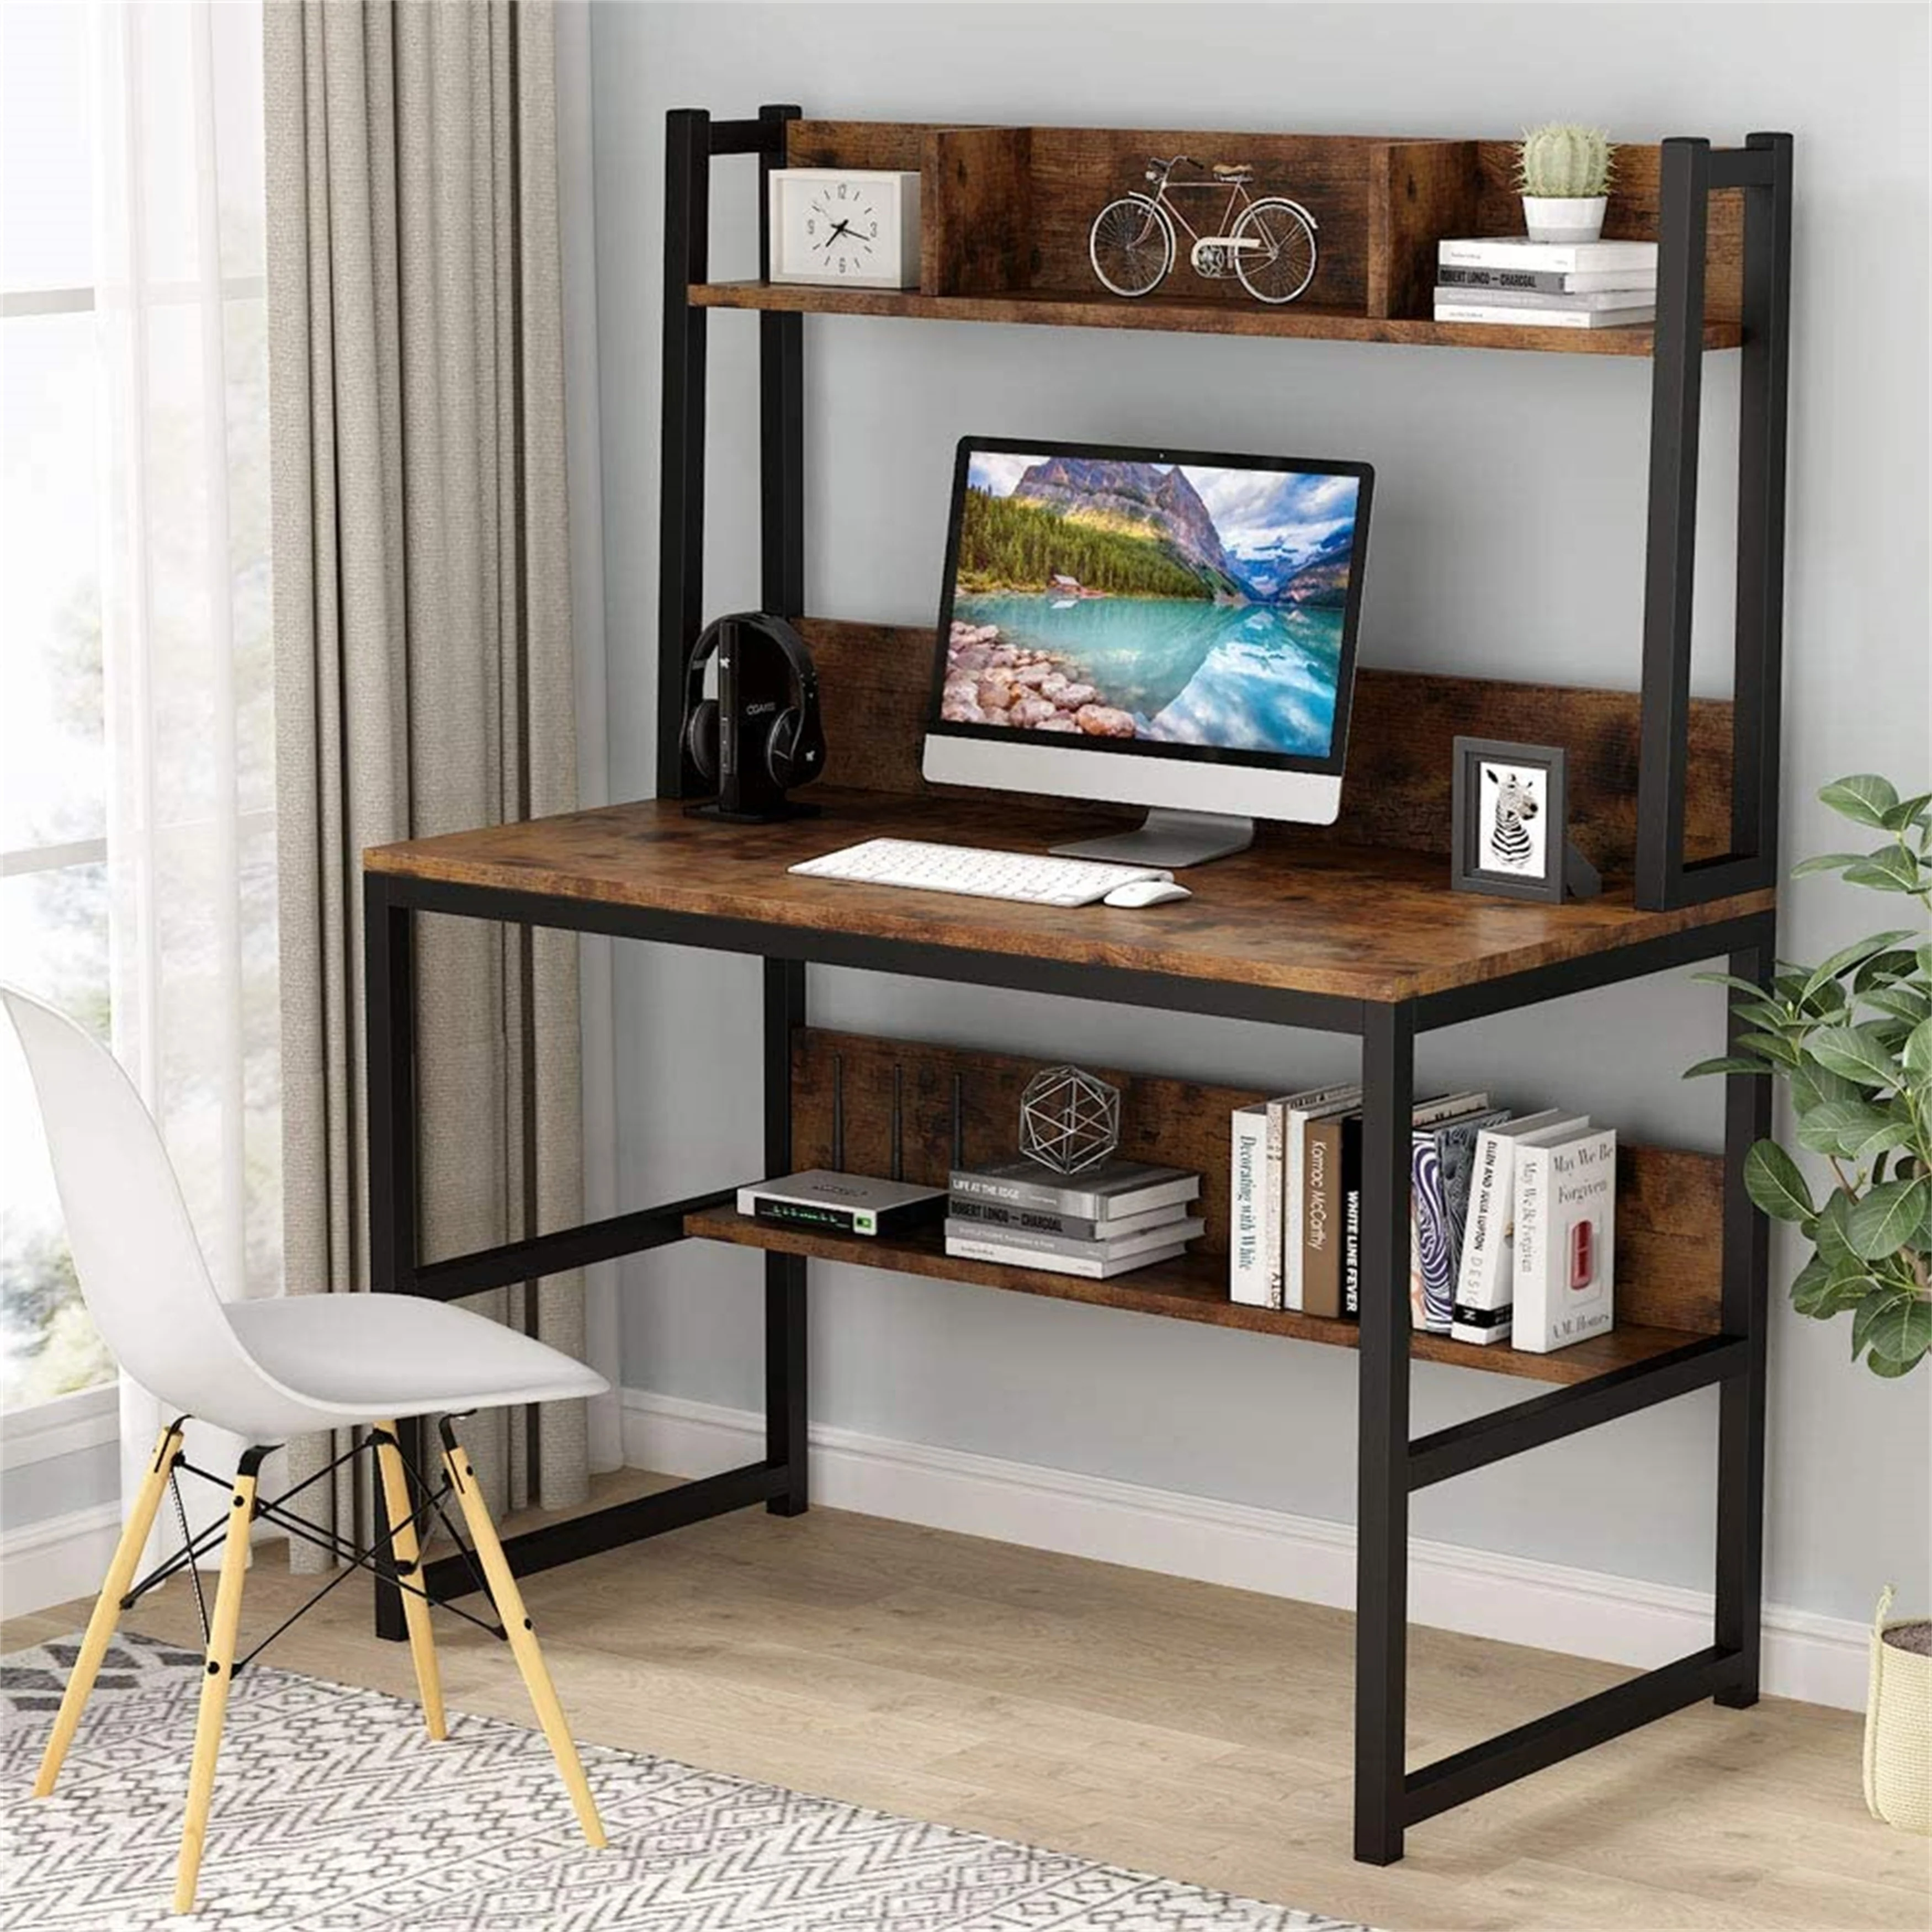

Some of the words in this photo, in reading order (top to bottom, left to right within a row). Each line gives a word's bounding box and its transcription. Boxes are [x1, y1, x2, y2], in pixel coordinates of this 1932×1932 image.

[871, 221, 877, 237] 3
[1237, 1135, 1257, 1202] Decorating
[953, 1179, 970, 1192] LIFE
[1240, 1205, 1256, 1231] with
[1346, 1190, 1360, 1234] WHITE
[1239, 1235, 1256, 1270] White
[1346, 1235, 1358, 1267] LINE
[1346, 1267, 1358, 1313] FEVER
